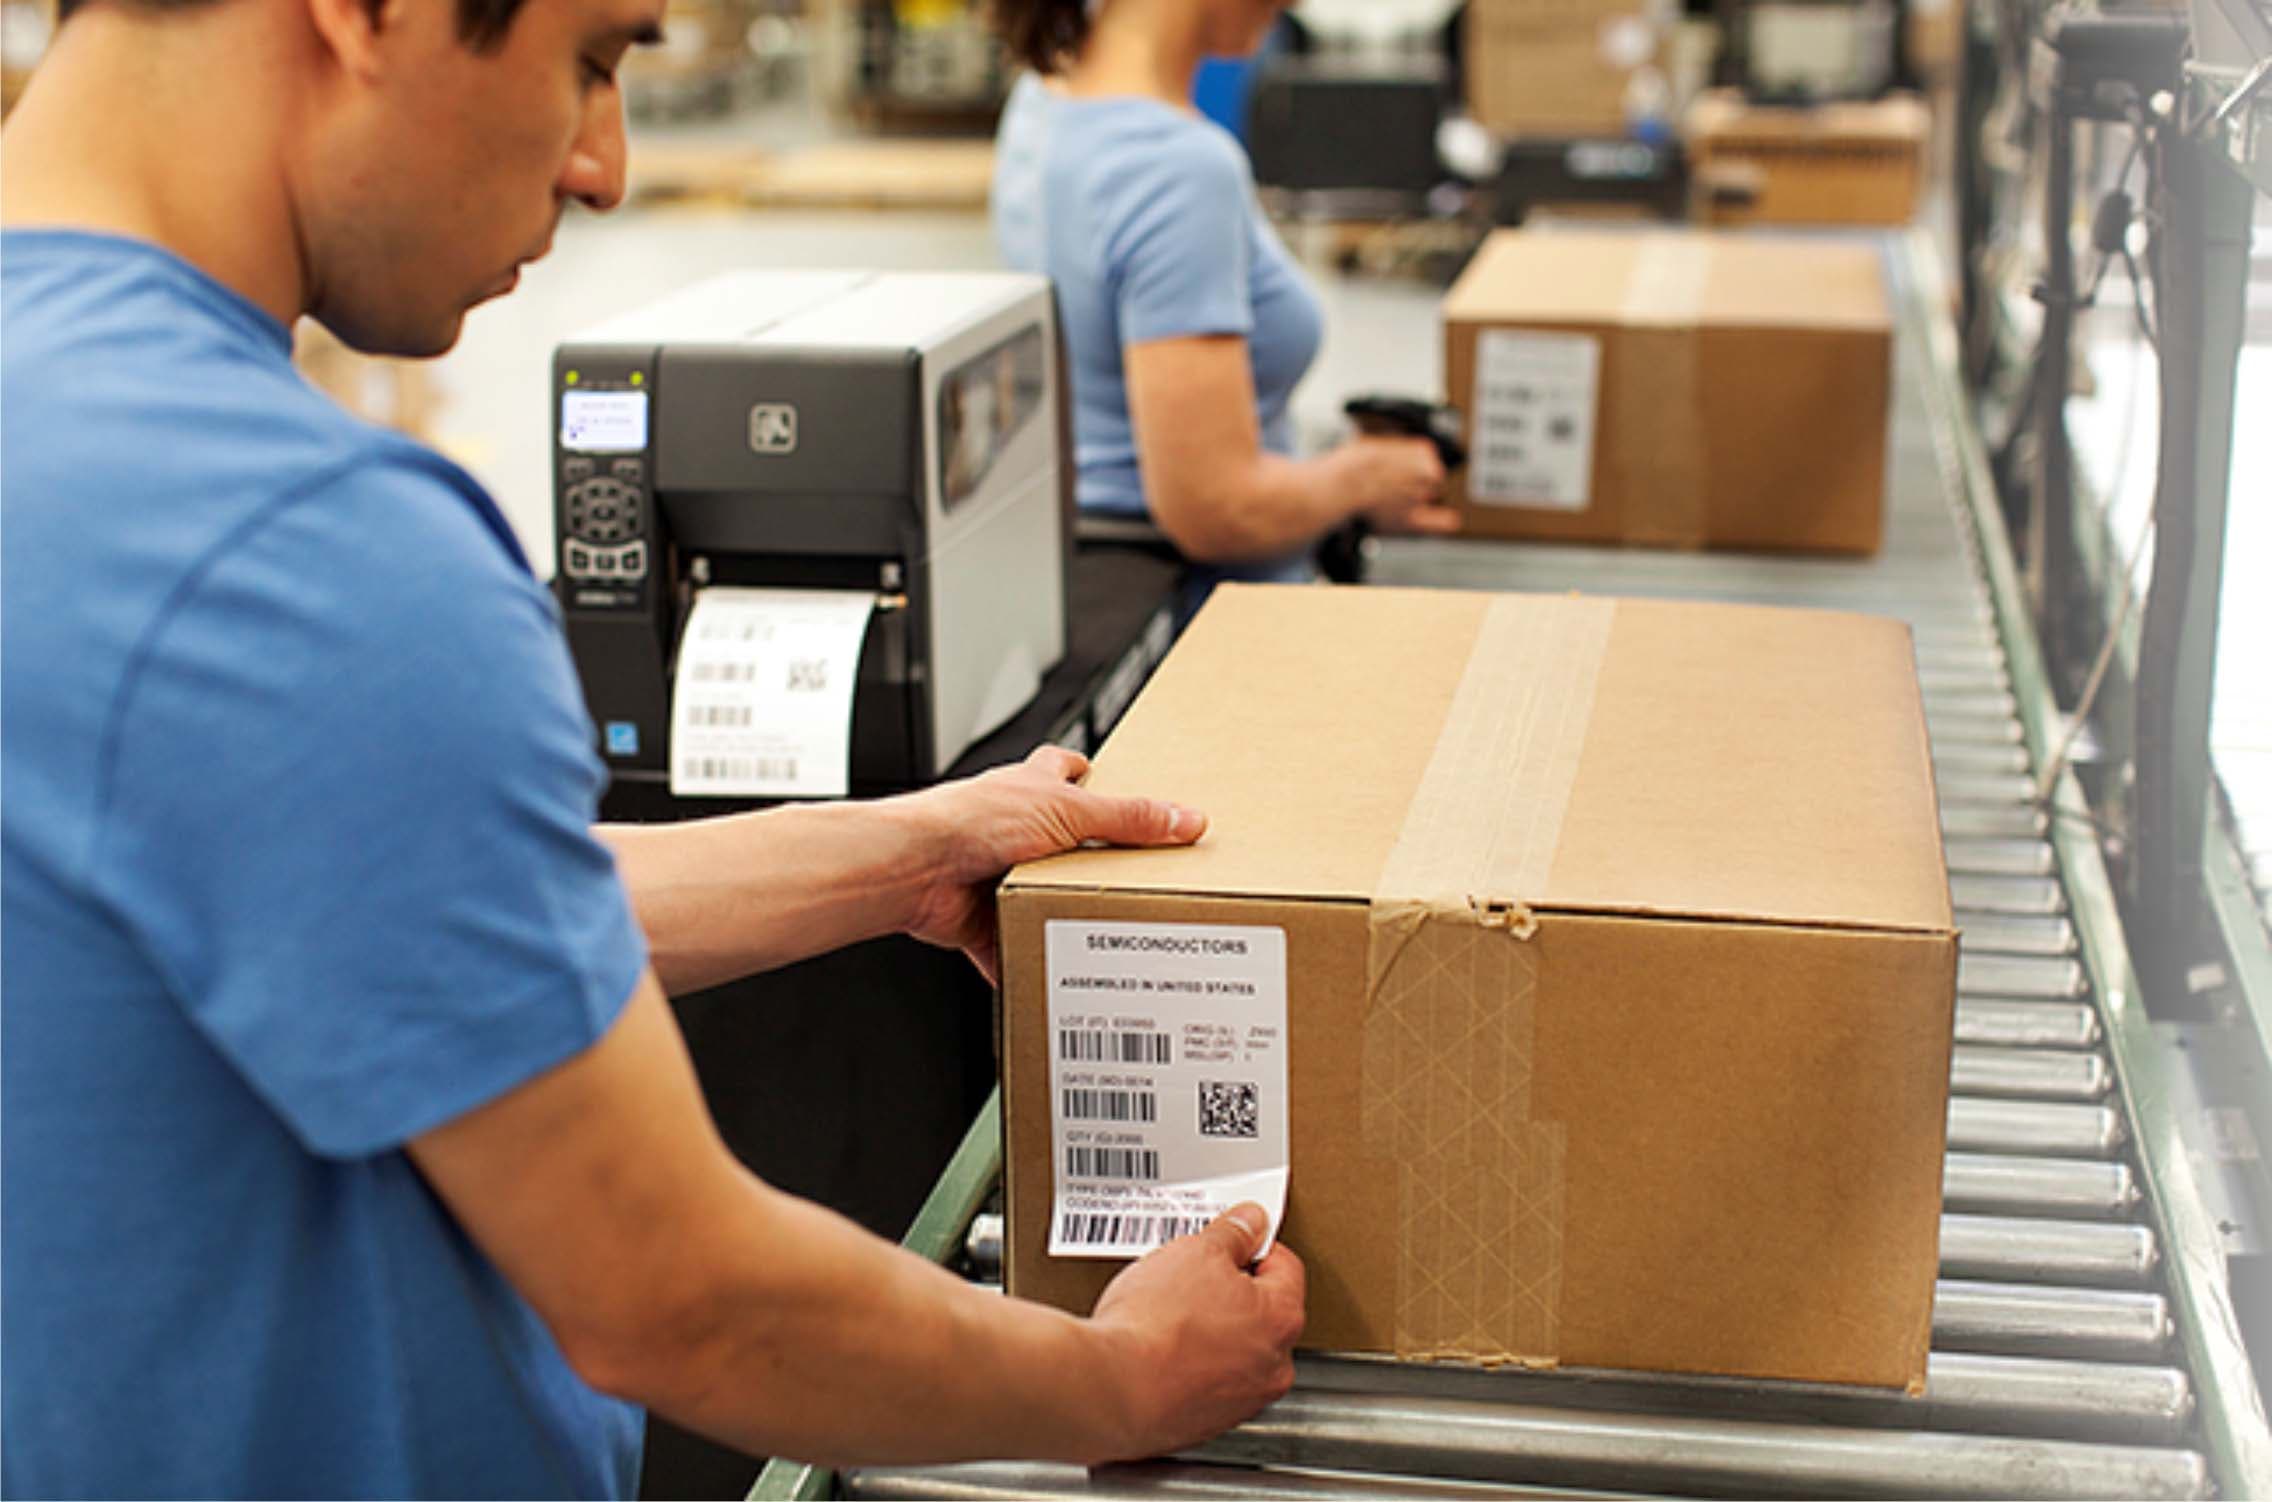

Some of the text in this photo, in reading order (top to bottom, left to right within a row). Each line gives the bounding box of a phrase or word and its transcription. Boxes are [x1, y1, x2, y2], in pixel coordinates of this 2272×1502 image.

[1086, 934, 1248, 955] SEMICONDUCTORS
[1059, 976, 1256, 995] ASSEMBLED IN UNITED STATES
